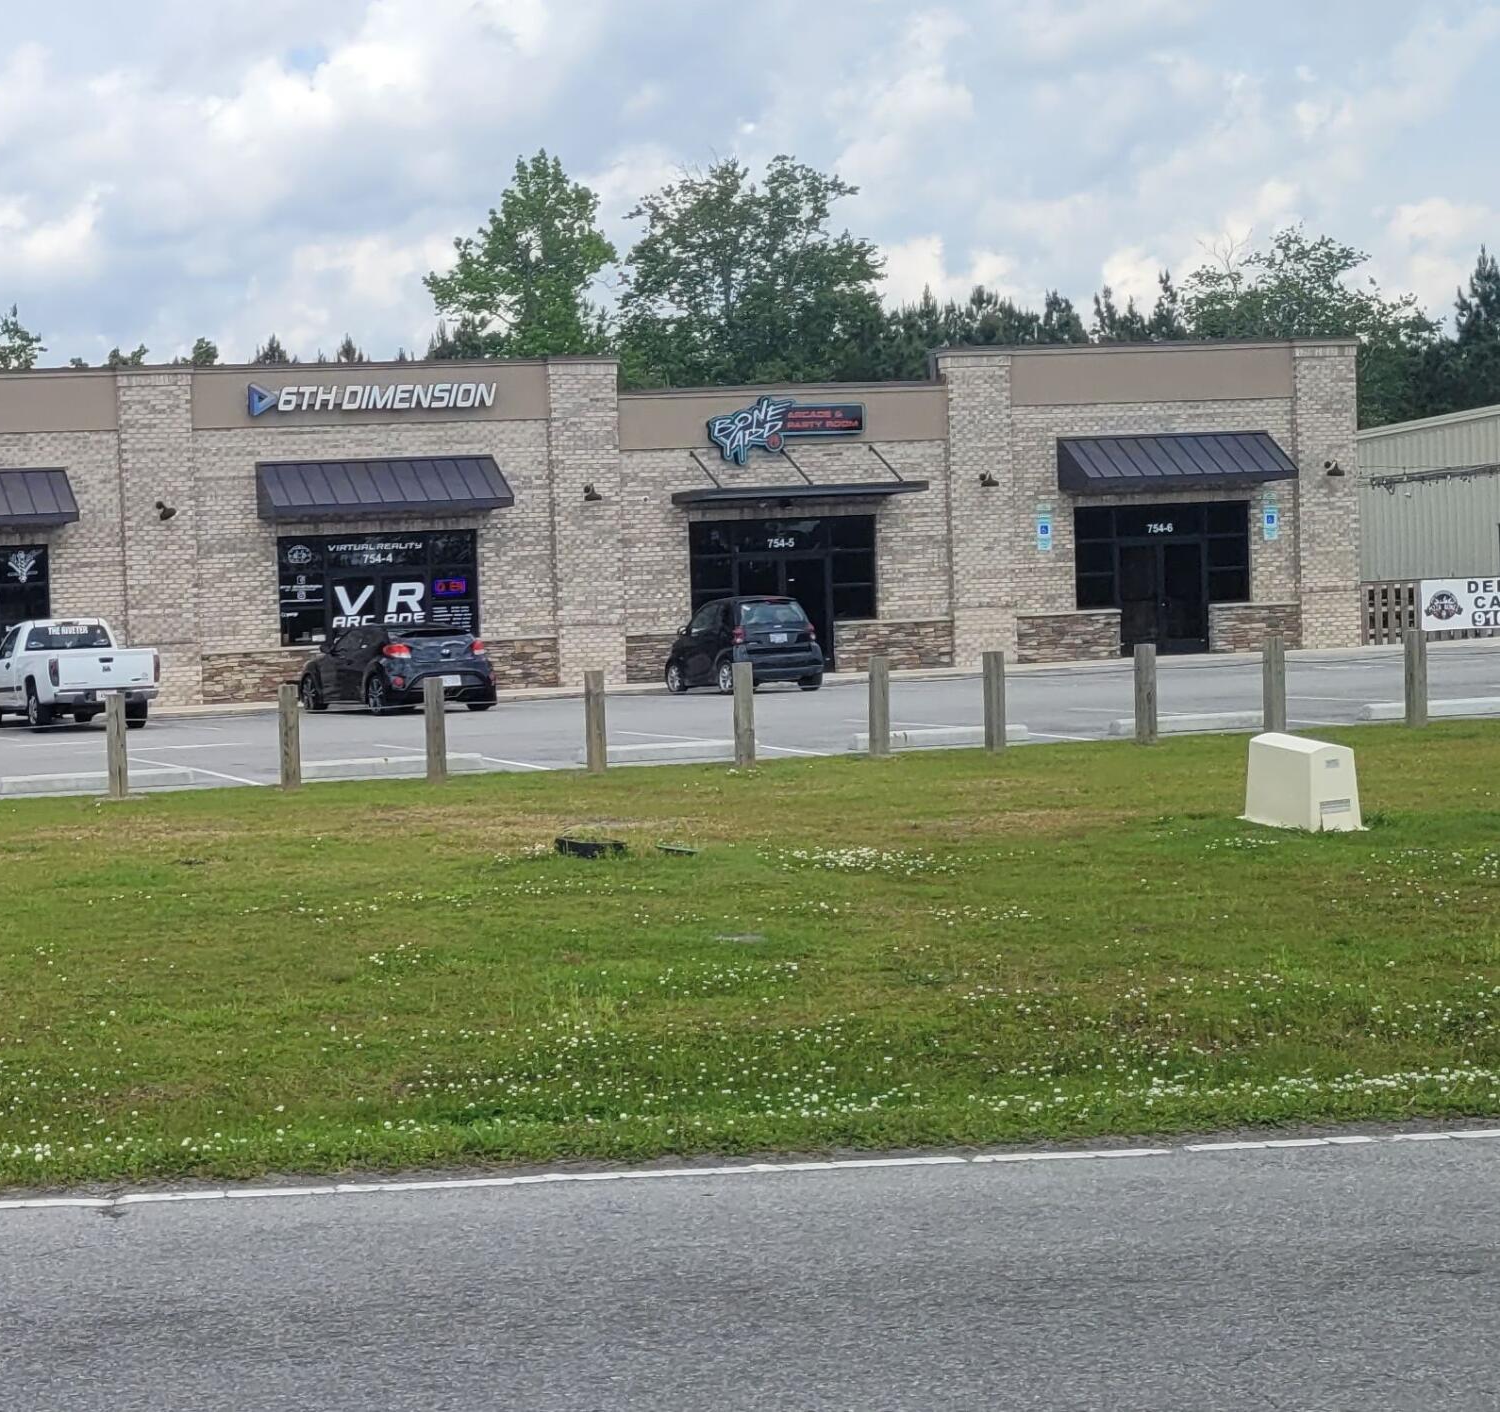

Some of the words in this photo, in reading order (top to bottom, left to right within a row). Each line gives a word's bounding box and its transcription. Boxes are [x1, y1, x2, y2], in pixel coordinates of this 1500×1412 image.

[278, 386, 338, 411] 6TH
[341, 382, 497, 410] DIMENSION
[714, 399, 793, 437] BONE
[787, 420, 822, 429] PARTY
[719, 421, 783, 461] YARD
[1147, 522, 1174, 534] 754-6
[327, 543, 376, 552] VIRTUAL
[376, 542, 423, 550] REALITY
[767, 538, 795, 548] 754-5
[363, 553, 393, 564] 754-4
[1467, 580, 1500, 593] DE
